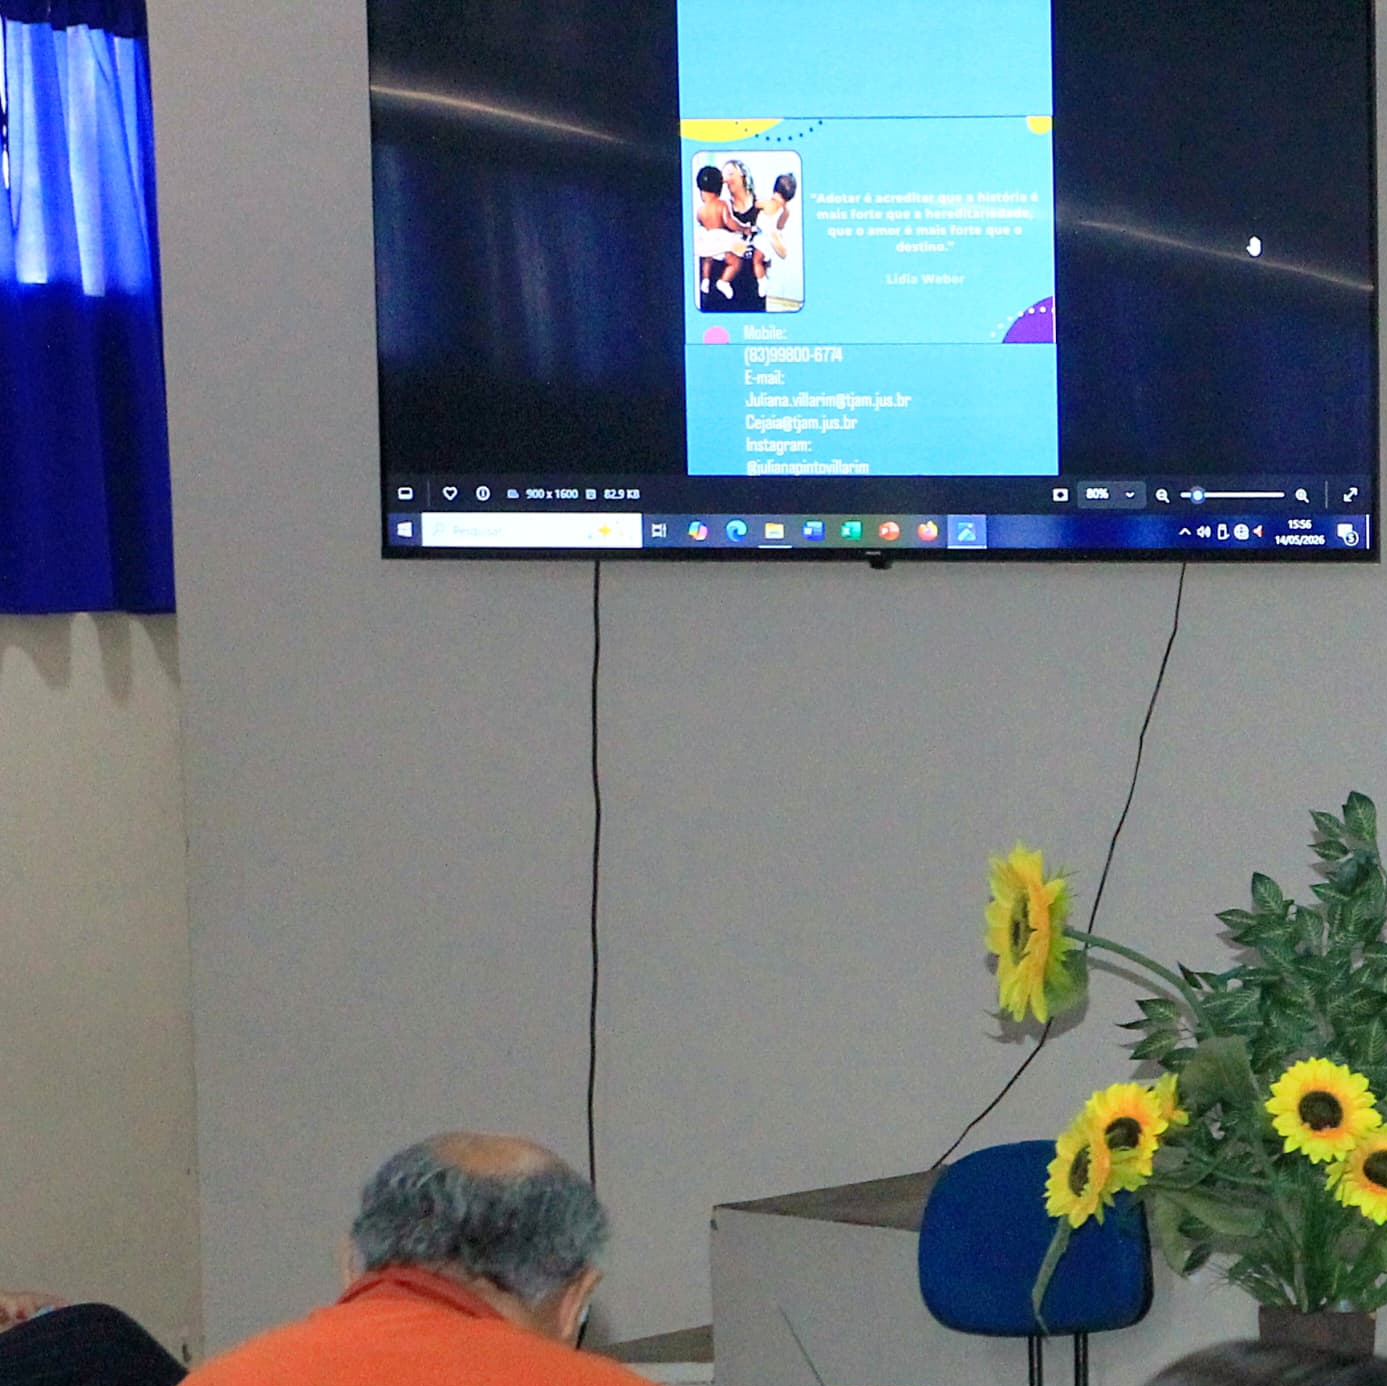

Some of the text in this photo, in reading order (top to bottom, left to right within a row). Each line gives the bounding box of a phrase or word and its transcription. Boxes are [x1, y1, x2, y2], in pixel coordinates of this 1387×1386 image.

[864, 192, 872, 203] é
[875, 191, 934, 203] acreditar
[937, 193, 962, 206] que
[966, 194, 974, 203] a
[977, 191, 1027, 203] história
[1030, 191, 1039, 203] é
[816, 208, 848, 220] mais
[850, 208, 882, 220] forte
[886, 210, 911, 222] que
[913, 210, 921, 220] a
[827, 224, 1023, 239] que o amor é mais forte que o
[921, 273, 966, 285] Weber
[743, 324, 788, 340] Mobile:
[744, 369, 785, 385] E-mail:
[746, 437, 813, 456] Instagram:
[525, 488, 545, 499] 900
[554, 488, 579, 499] 1600
[603, 488, 641, 499] 82.9 KB
[1085, 488, 1109, 499] 80%
